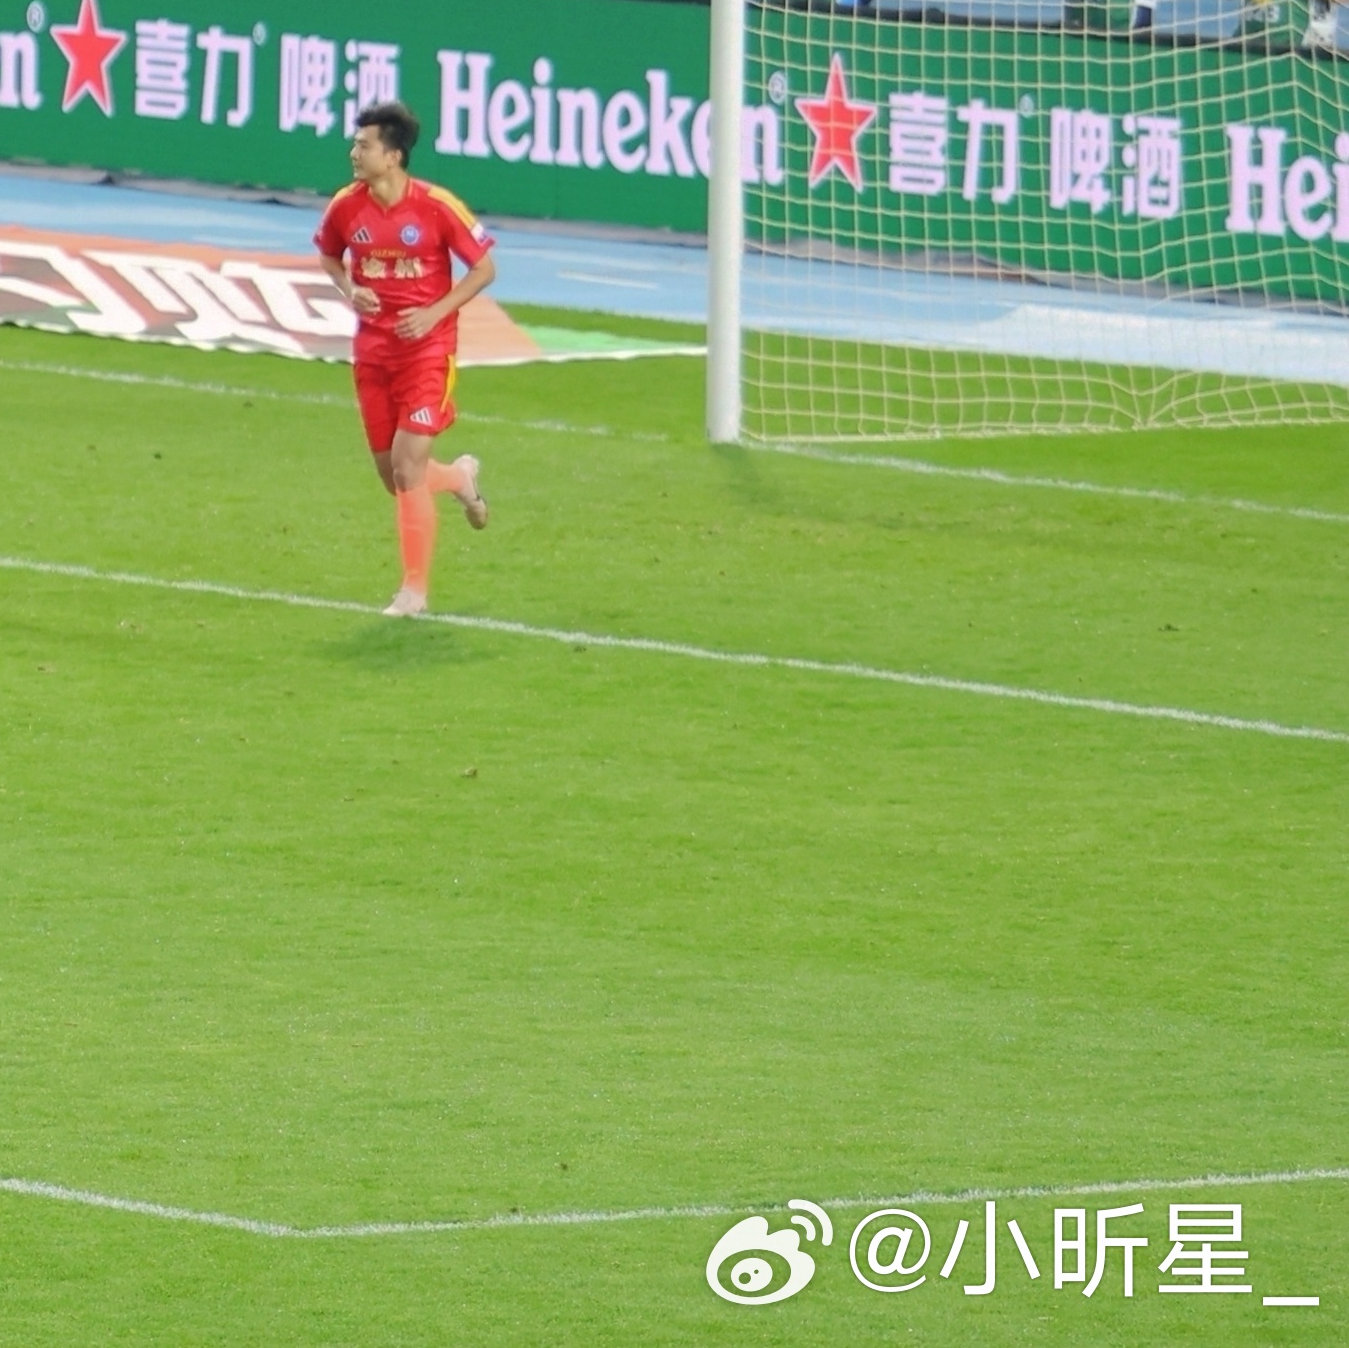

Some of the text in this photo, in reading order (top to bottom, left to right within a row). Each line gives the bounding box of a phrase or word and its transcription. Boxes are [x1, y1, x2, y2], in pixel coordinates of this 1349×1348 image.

[134, 19, 401, 140] 喜力 啤酒
[887, 91, 1185, 221] 喜力 啤酒
